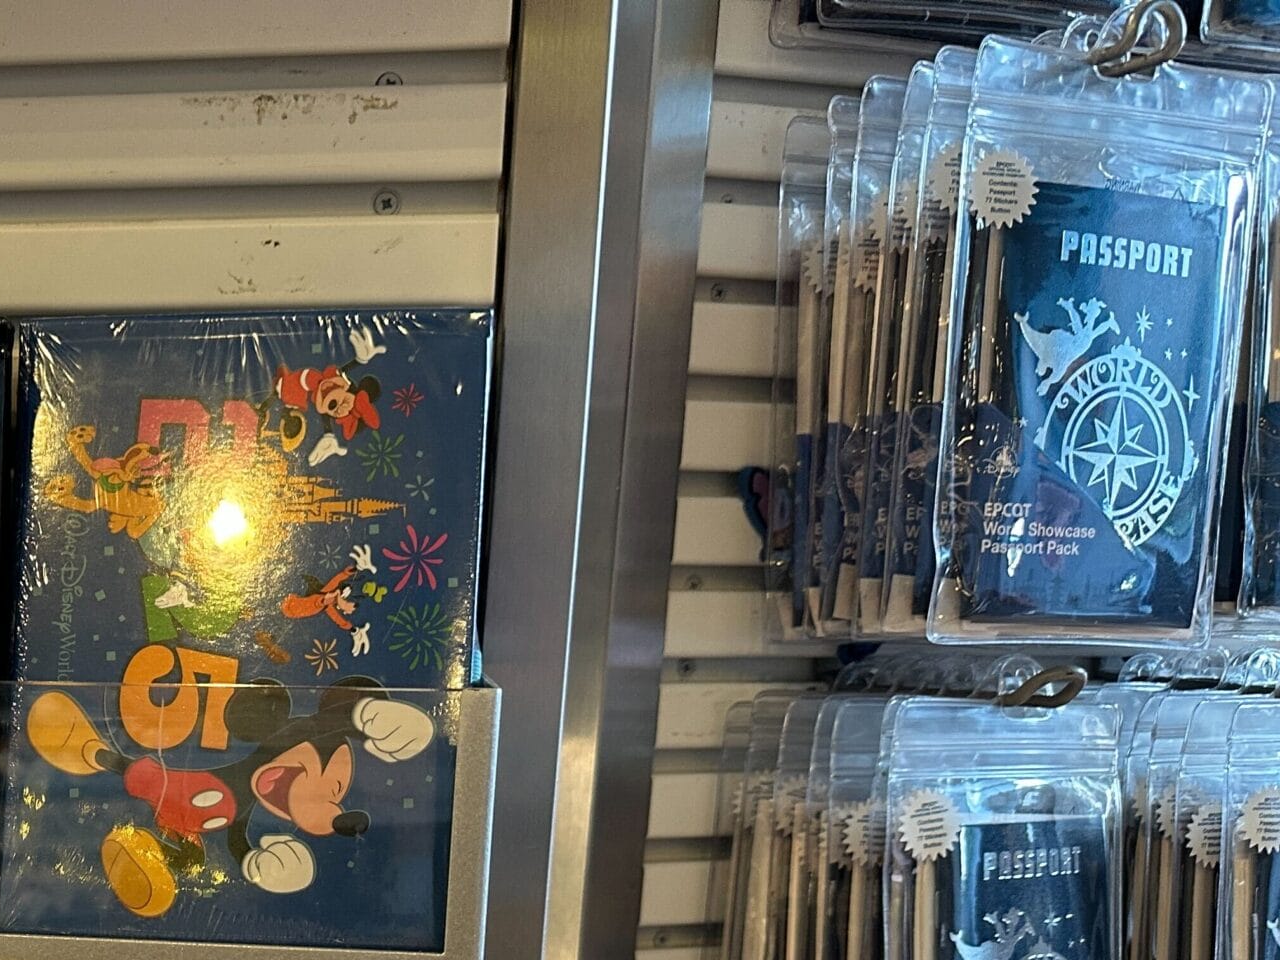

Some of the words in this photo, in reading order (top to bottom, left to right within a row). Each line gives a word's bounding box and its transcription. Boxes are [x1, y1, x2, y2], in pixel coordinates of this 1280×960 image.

[1060, 229, 1193, 278] PASSPORT
[1056, 356, 1172, 410] WORLD
[983, 502, 1032, 518] EPCOT
[983, 521, 1024, 537] Wor
[1028, 522, 1096, 539] Showcase
[1046, 541, 1081, 556] Pack
[52, 555, 88, 635] Disney
[983, 846, 1081, 881] PASSPORT
